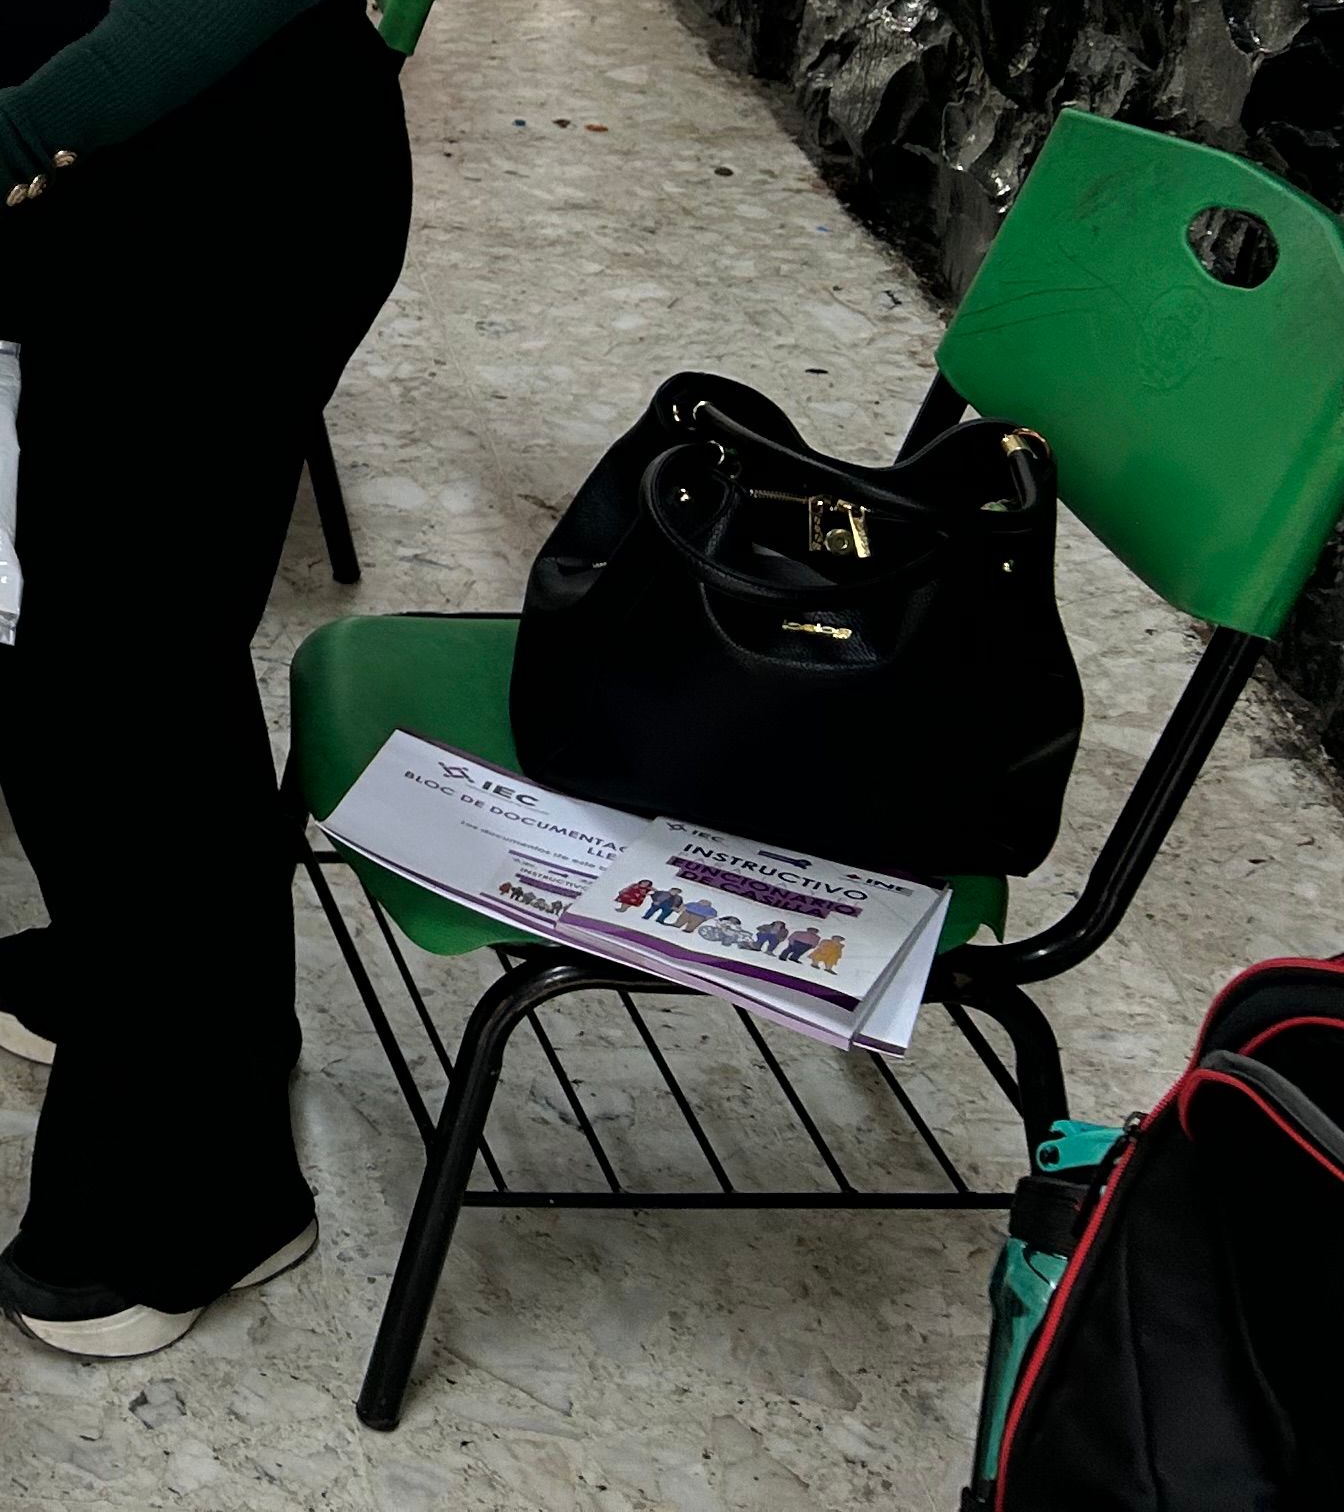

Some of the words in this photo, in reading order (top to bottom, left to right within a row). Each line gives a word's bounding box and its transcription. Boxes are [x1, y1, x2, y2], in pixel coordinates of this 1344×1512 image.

[404, 770, 455, 796] BLOC
[460, 794, 486, 808] DE
[481, 780, 539, 807] IEC
[671, 857, 857, 916] FUNCIONARIO
[678, 871, 717, 887] DE
[719, 882, 824, 919] CASILLA
[683, 843, 868, 901] INSTRUCTIVO
